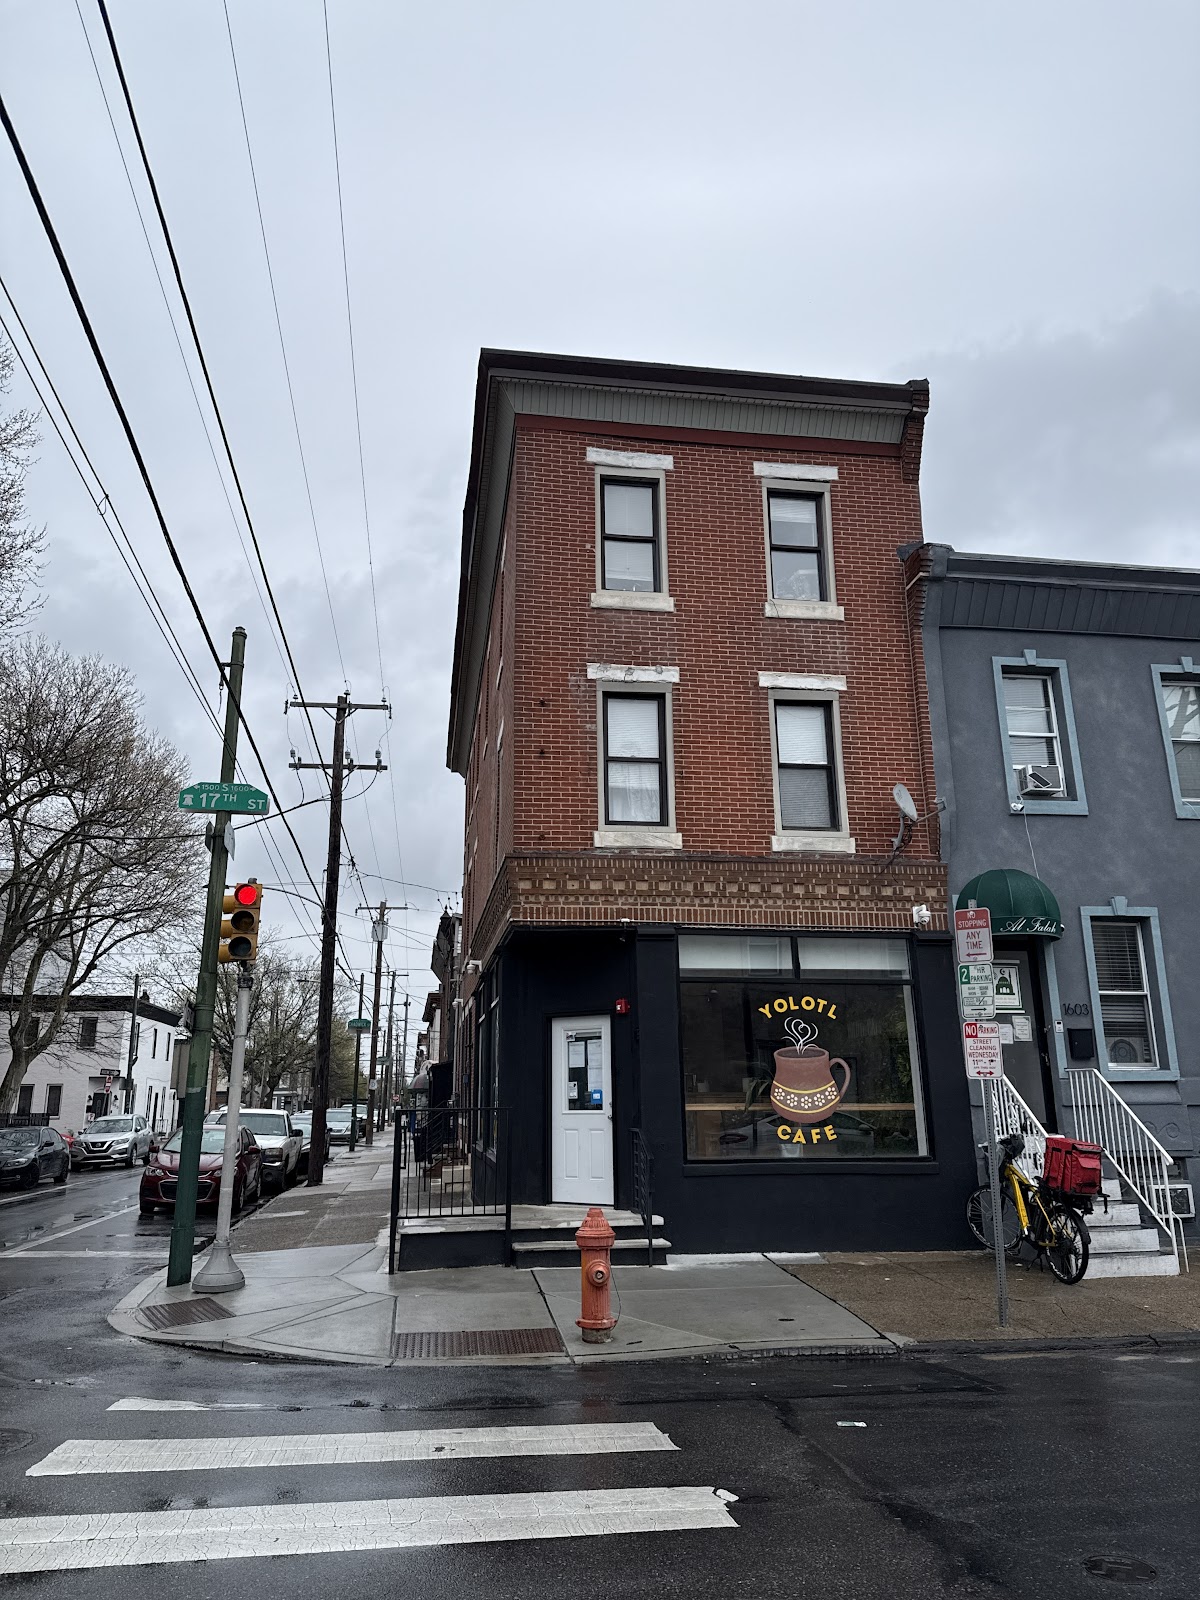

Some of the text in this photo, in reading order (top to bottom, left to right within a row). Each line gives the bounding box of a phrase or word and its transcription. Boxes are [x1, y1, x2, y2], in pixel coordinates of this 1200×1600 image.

[222, 783, 229, 792] S
[247, 799, 265, 810] ST
[967, 911, 976, 919] NO
[958, 919, 987, 928] STOPPING
[1000, 916, 1057, 934] Al Falah
[966, 930, 981, 940] ANY
[966, 940, 983, 950] TIME
[961, 968, 969, 982] 2
[970, 974, 992, 983] PARKING
[758, 996, 837, 1020] YOLOTL
[1063, 1003, 1089, 1016] 1603
[965, 1024, 977, 1036] NO
[978, 1026, 997, 1034] PARKING
[968, 1051, 999, 1059] WEDNESDAY
[777, 1125, 838, 1144] CAFE
